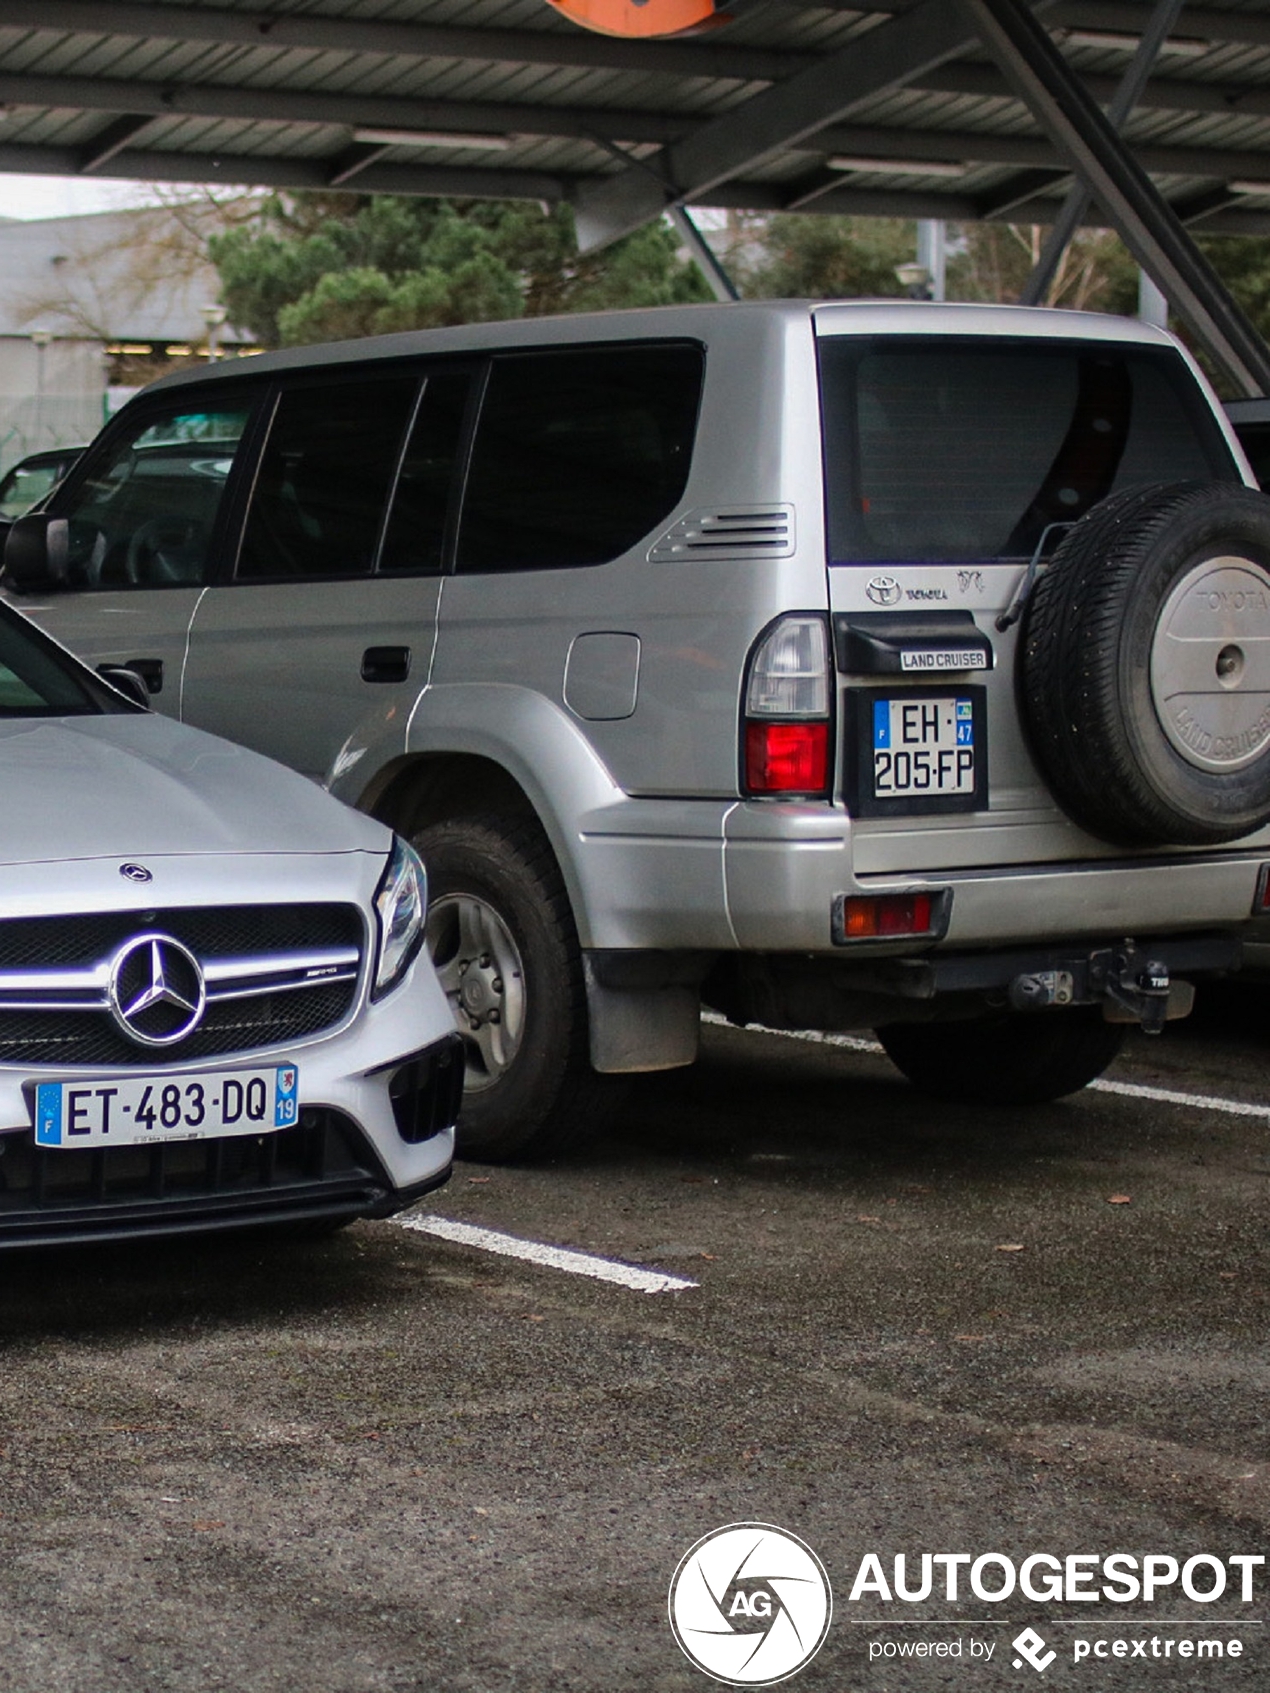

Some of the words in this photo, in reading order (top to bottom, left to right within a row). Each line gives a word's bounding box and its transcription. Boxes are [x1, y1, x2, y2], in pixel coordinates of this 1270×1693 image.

[1195, 590, 1269, 613] TOYOTA
[903, 653, 934, 668] LAND
[936, 652, 984, 667] CRUISER
[879, 730, 885, 740] F
[958, 725, 972, 742] 47
[277, 1100, 295, 1120] 19
[44, 1119, 53, 1133] F
